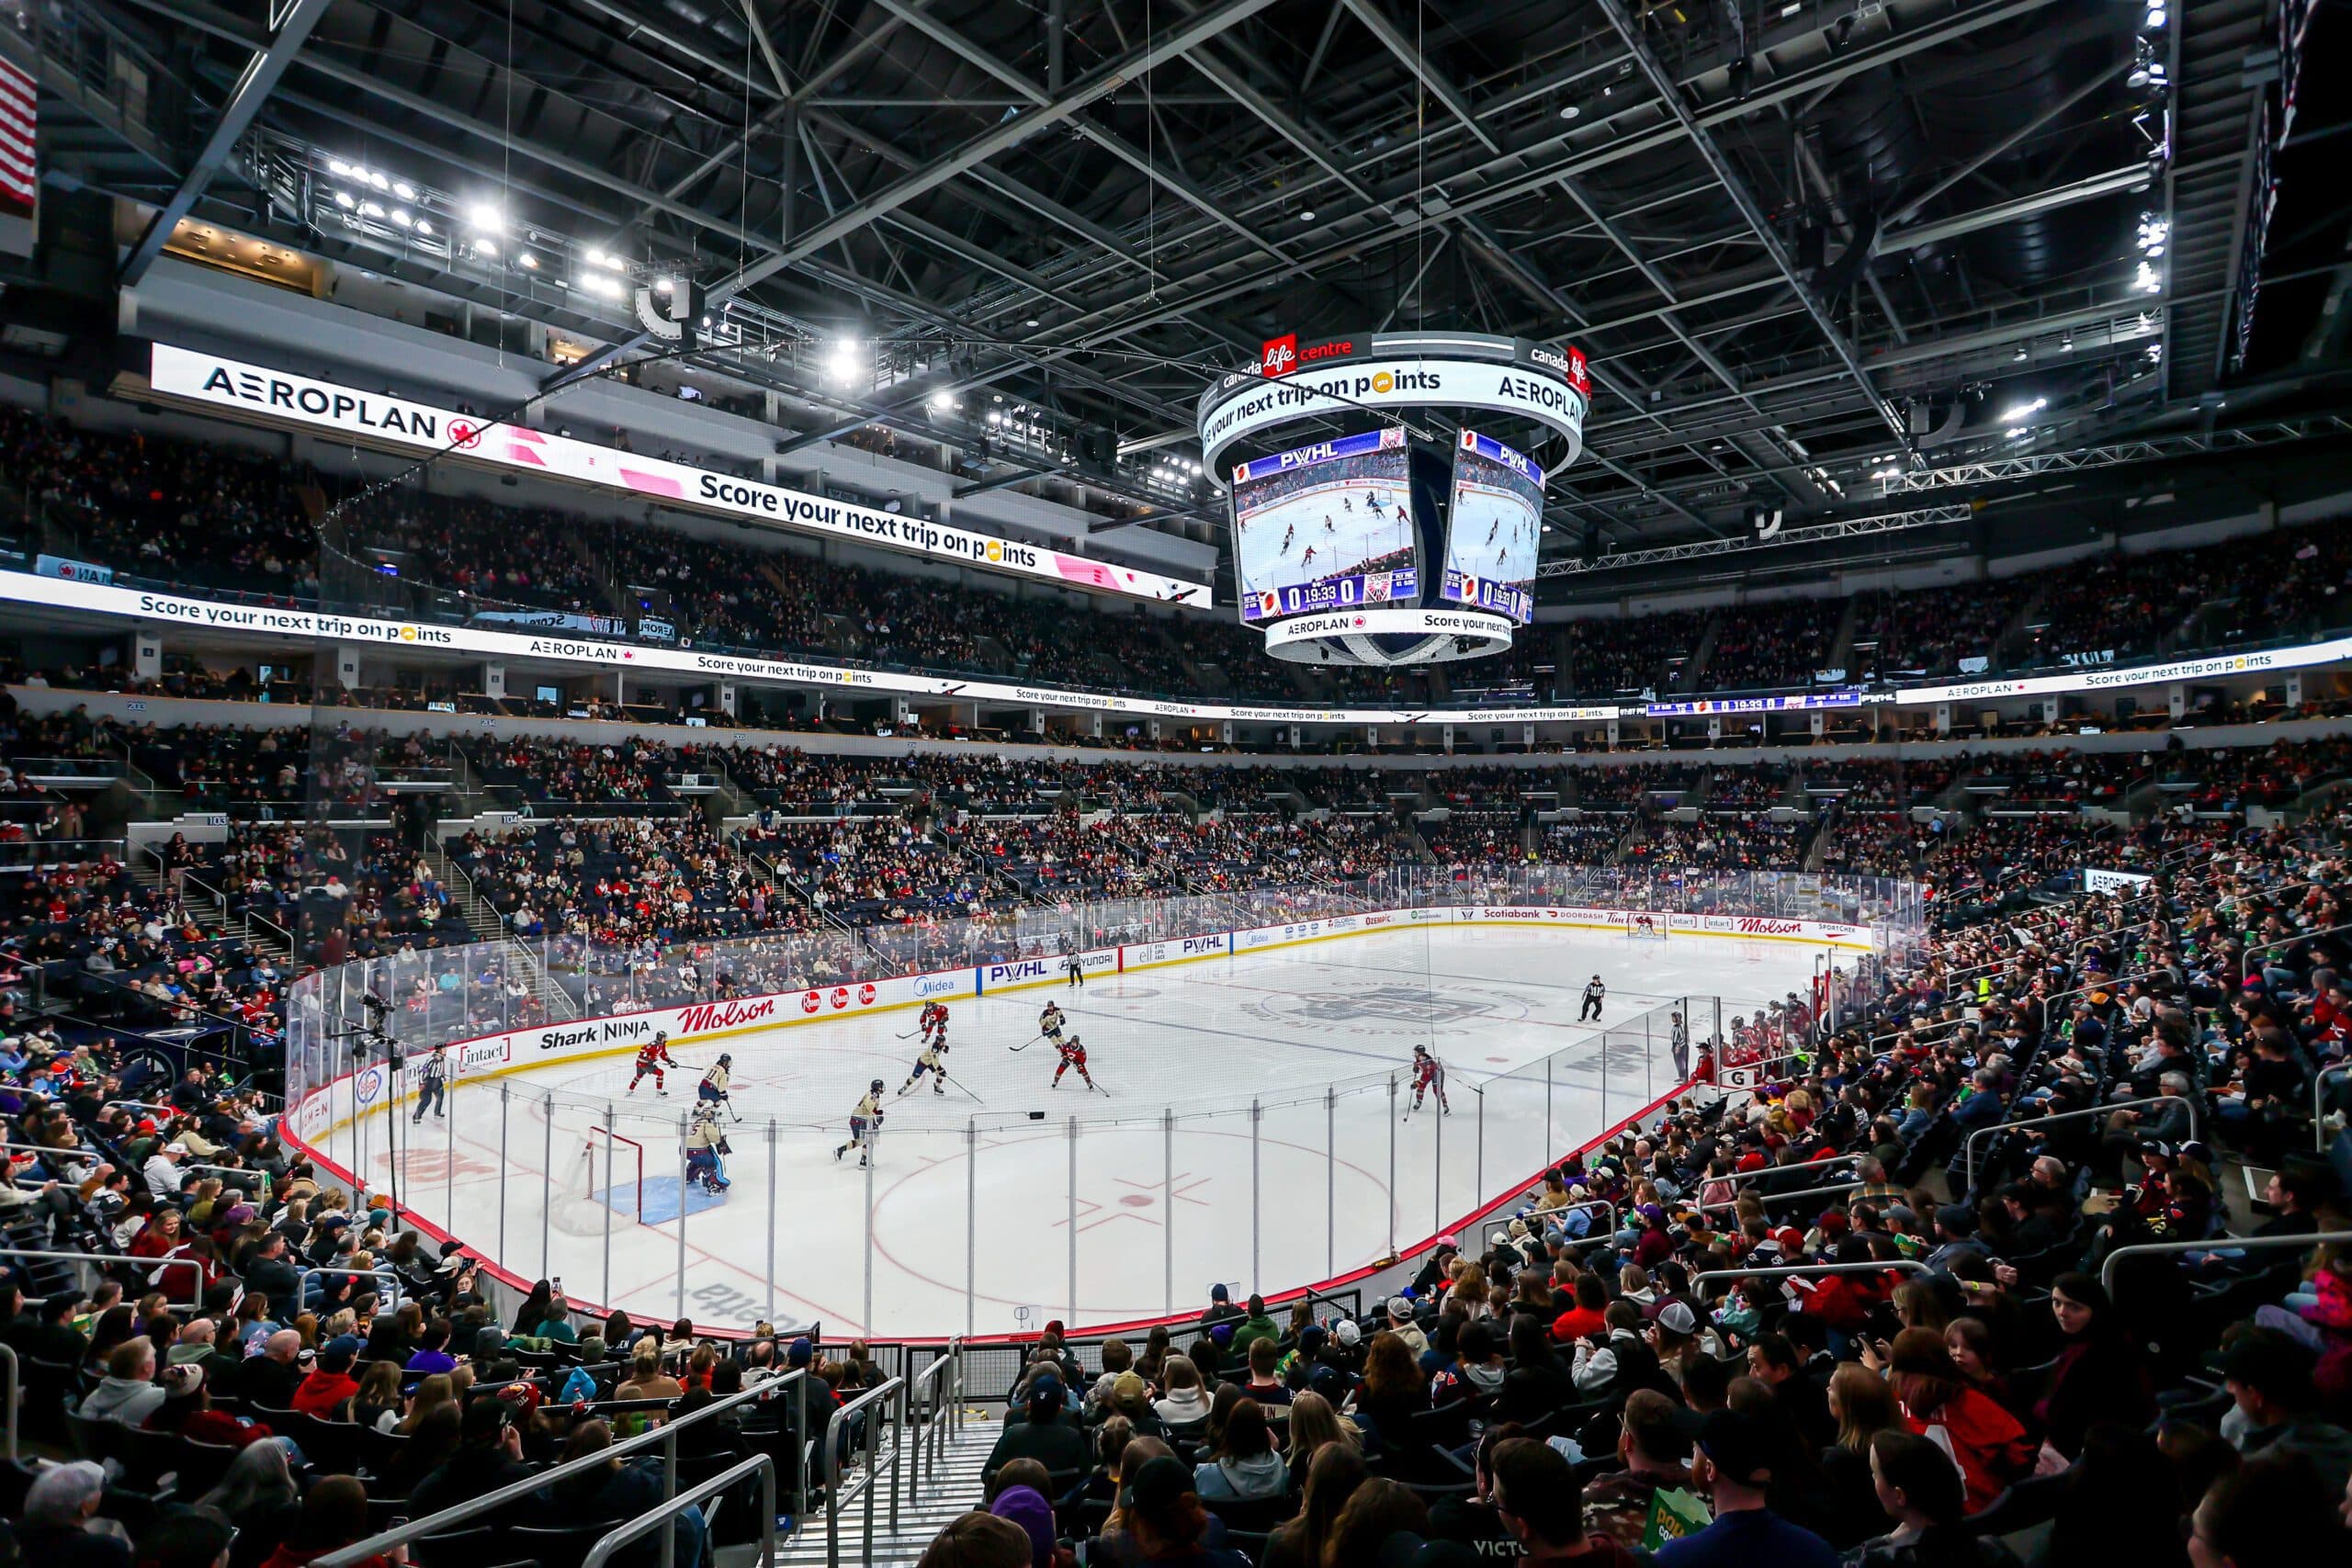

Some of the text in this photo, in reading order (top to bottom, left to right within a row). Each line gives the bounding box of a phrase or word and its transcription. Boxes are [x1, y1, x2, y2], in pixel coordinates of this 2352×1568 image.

[1263, 344, 1295, 372] life
[1299, 341, 1353, 361] centre
[1531, 348, 1587, 385] canada life
[202, 367, 436, 439] AEROPLAN
[1212, 411, 1235, 439] your
[1238, 392, 1273, 419] next
[1277, 382, 1314, 406] trip
[1319, 379, 1349, 397] on
[1498, 376, 1581, 427] AEROPLAN
[1280, 443, 1339, 468] PWHL
[1500, 446, 1529, 473] PWHL
[700, 474, 1036, 569] Score your next trip on points
[1288, 580, 1354, 611] 0 19:33 0
[1483, 581, 1493, 605] 0
[1510, 591, 1518, 614] 0
[141, 594, 451, 644] Score your next trip on points
[1288, 617, 1349, 636] AEROPLAN
[1424, 615, 1460, 626] Score
[1462, 618, 1486, 630] your
[1487, 621, 1502, 633] next
[530, 640, 617, 660] AEROPLAN
[697, 656, 872, 683] Score your next trip on points
[2086, 655, 2272, 686] Score your next trip on points
[1016, 688, 1039, 700] Score
[1040, 692, 1059, 704] your
[1059, 694, 1078, 705] next
[1078, 694, 1091, 708] trip
[1091, 697, 1102, 706] on
[1948, 683, 2012, 697] AEROPLAN
[1155, 703, 1190, 715] AEROPLAN
[1230, 708, 1253, 718] Score
[1253, 710, 1272, 721] your
[1272, 710, 1290, 719] next
[1290, 710, 1305, 722] trip
[1306, 712, 1316, 720] on
[1467, 711, 1493, 720] Score
[1495, 711, 1515, 721] your
[1517, 709, 1538, 719] next
[1539, 709, 1555, 720] trip
[1557, 710, 1569, 718] on
[209, 816, 227, 825] 103
[503, 815, 518, 824] 104
[1484, 908, 1541, 919] Scotiabank
[1560, 911, 1603, 919] DOORDASH
[1606, 912, 1624, 924] Tim
[1671, 917, 1694, 926] intact
[1707, 919, 1731, 928] intact
[1737, 918, 1801, 933] Molson
[1183, 935, 1223, 953] PWHL
[1080, 953, 1113, 966] YUNDAI
[990, 960, 1047, 982] PWHL
[920, 979, 955, 994] Midea
[677, 998, 775, 1033] Molson
[540, 1020, 650, 1050] Shark NINJA
[467, 1043, 503, 1064] intact
[705, 1068, 718, 1080] 11
[1731, 1071, 1746, 1086] G
